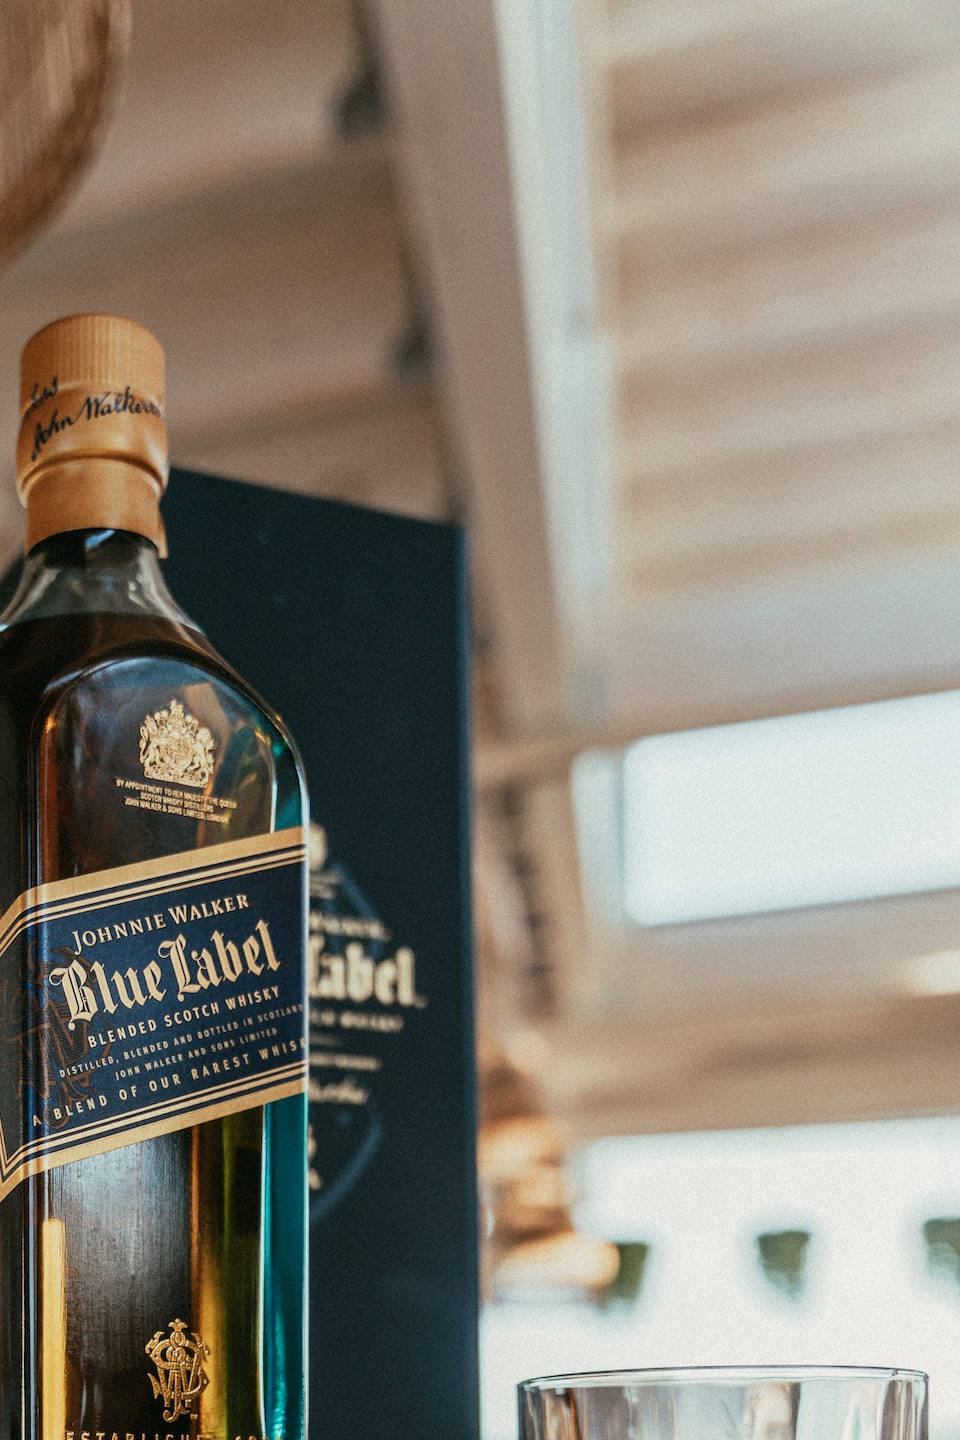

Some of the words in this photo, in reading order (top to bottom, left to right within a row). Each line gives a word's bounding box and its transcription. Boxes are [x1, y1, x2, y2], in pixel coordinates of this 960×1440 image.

[72, 914, 166, 955] JOHNNIE
[168, 894, 249, 925] WALKER
[48, 959, 167, 1031] Blue
[157, 919, 281, 1002] Label
[59, 1055, 120, 1078] DISTILLED,
[123, 1040, 169, 1060] BLENDED
[174, 1034, 193, 1046] AND
[197, 1021, 239, 1041] BOTTLED
[243, 1016, 253, 1026] IN
[257, 1003, 303, 1023] SCOTLAND
[87, 1019, 157, 1048] BLENDED
[164, 1002, 220, 1027] SCOTCH
[225, 985, 279, 1011] WHISKY
[115, 1066, 140, 1080] JOHN
[145, 1053, 183, 1071] WALKER
[188, 1047, 207, 1059] AND
[210, 1039, 236, 1053] SONS
[239, 1027, 278, 1044] LIMITED
[32, 1114, 42, 1127] A
[53, 1094, 107, 1120] BLEND
[119, 1085, 137, 1101] OF
[149, 1073, 181, 1092] OUR
[190, 1053, 250, 1080] RAREST
